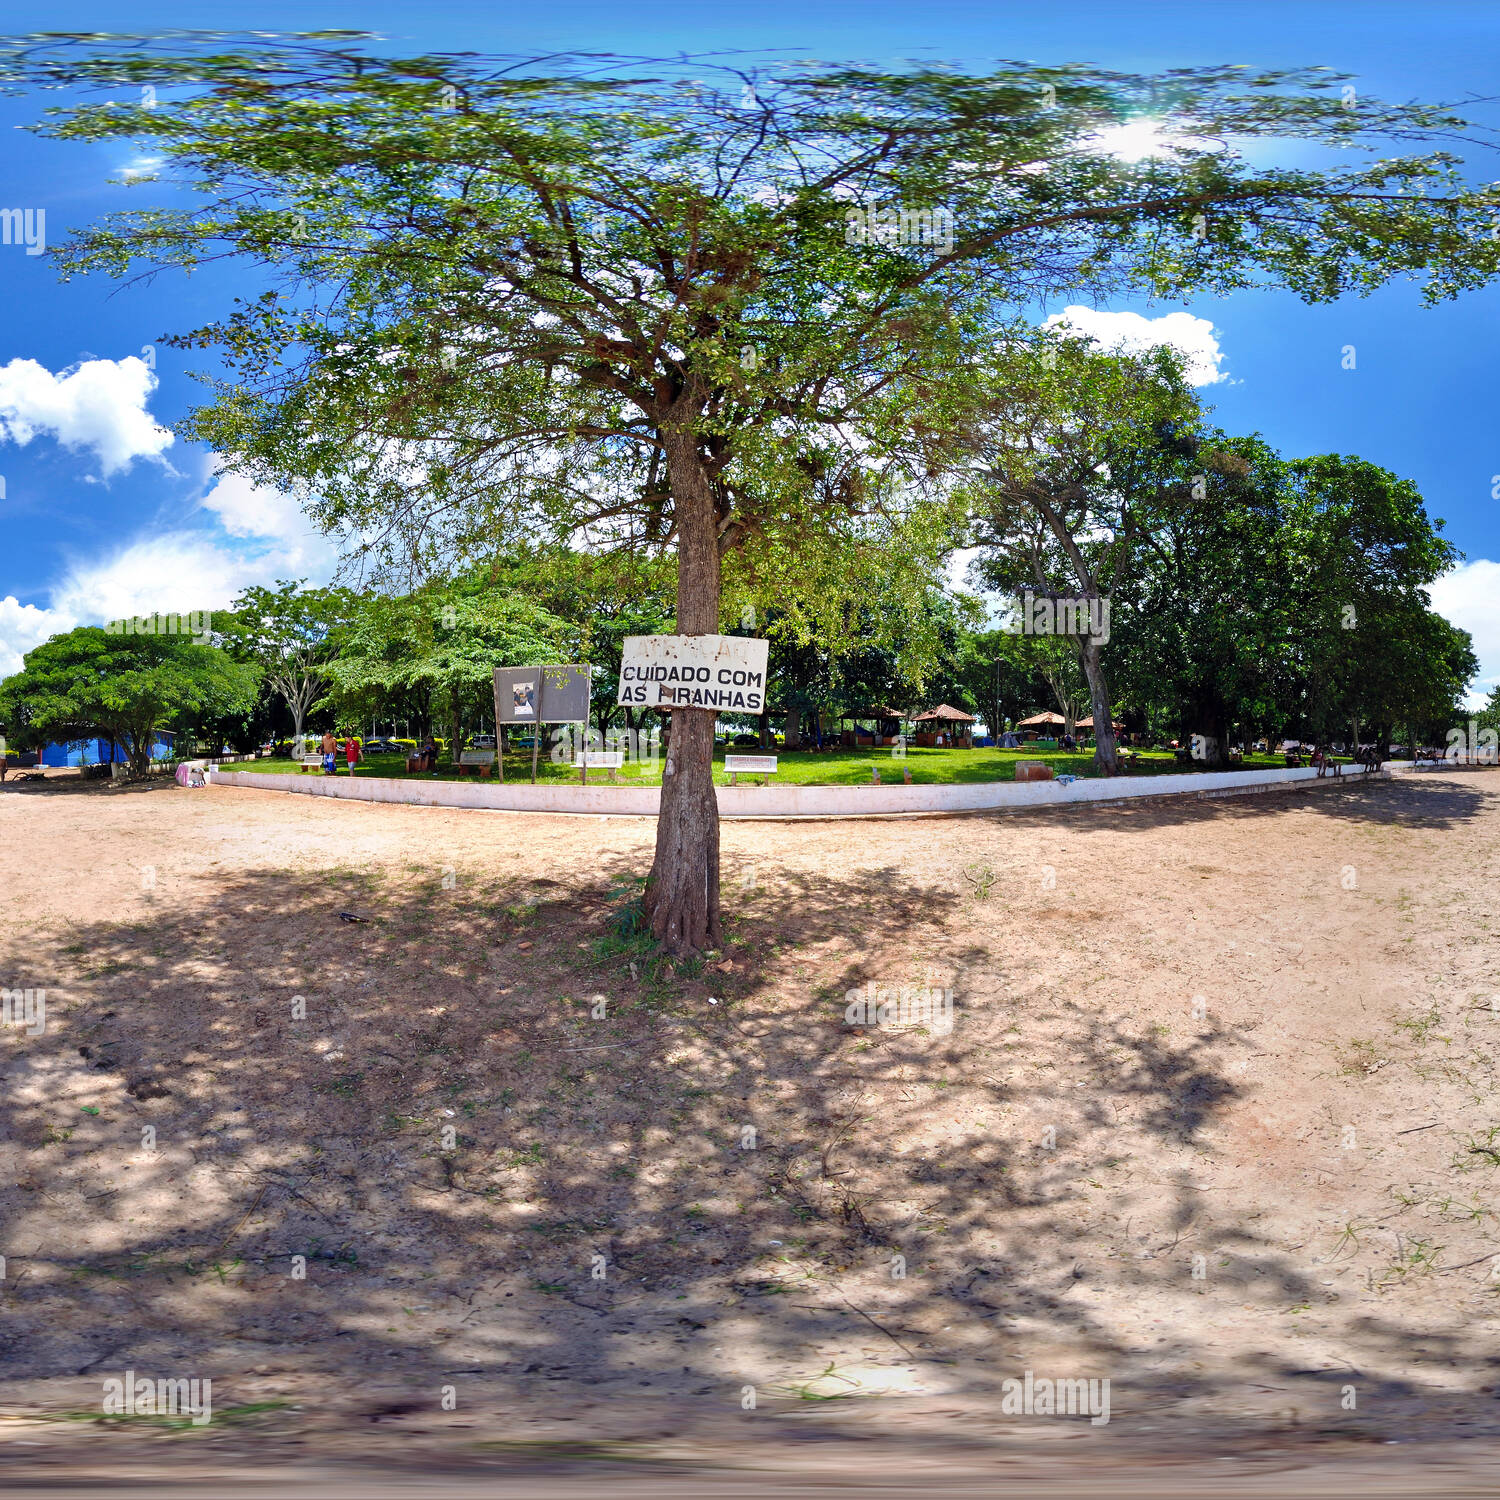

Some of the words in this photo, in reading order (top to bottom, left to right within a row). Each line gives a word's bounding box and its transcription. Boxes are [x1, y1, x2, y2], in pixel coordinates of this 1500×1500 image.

[623, 666, 711, 683] CUIDADO
[718, 669, 762, 688] COM
[621, 686, 647, 702] AS
